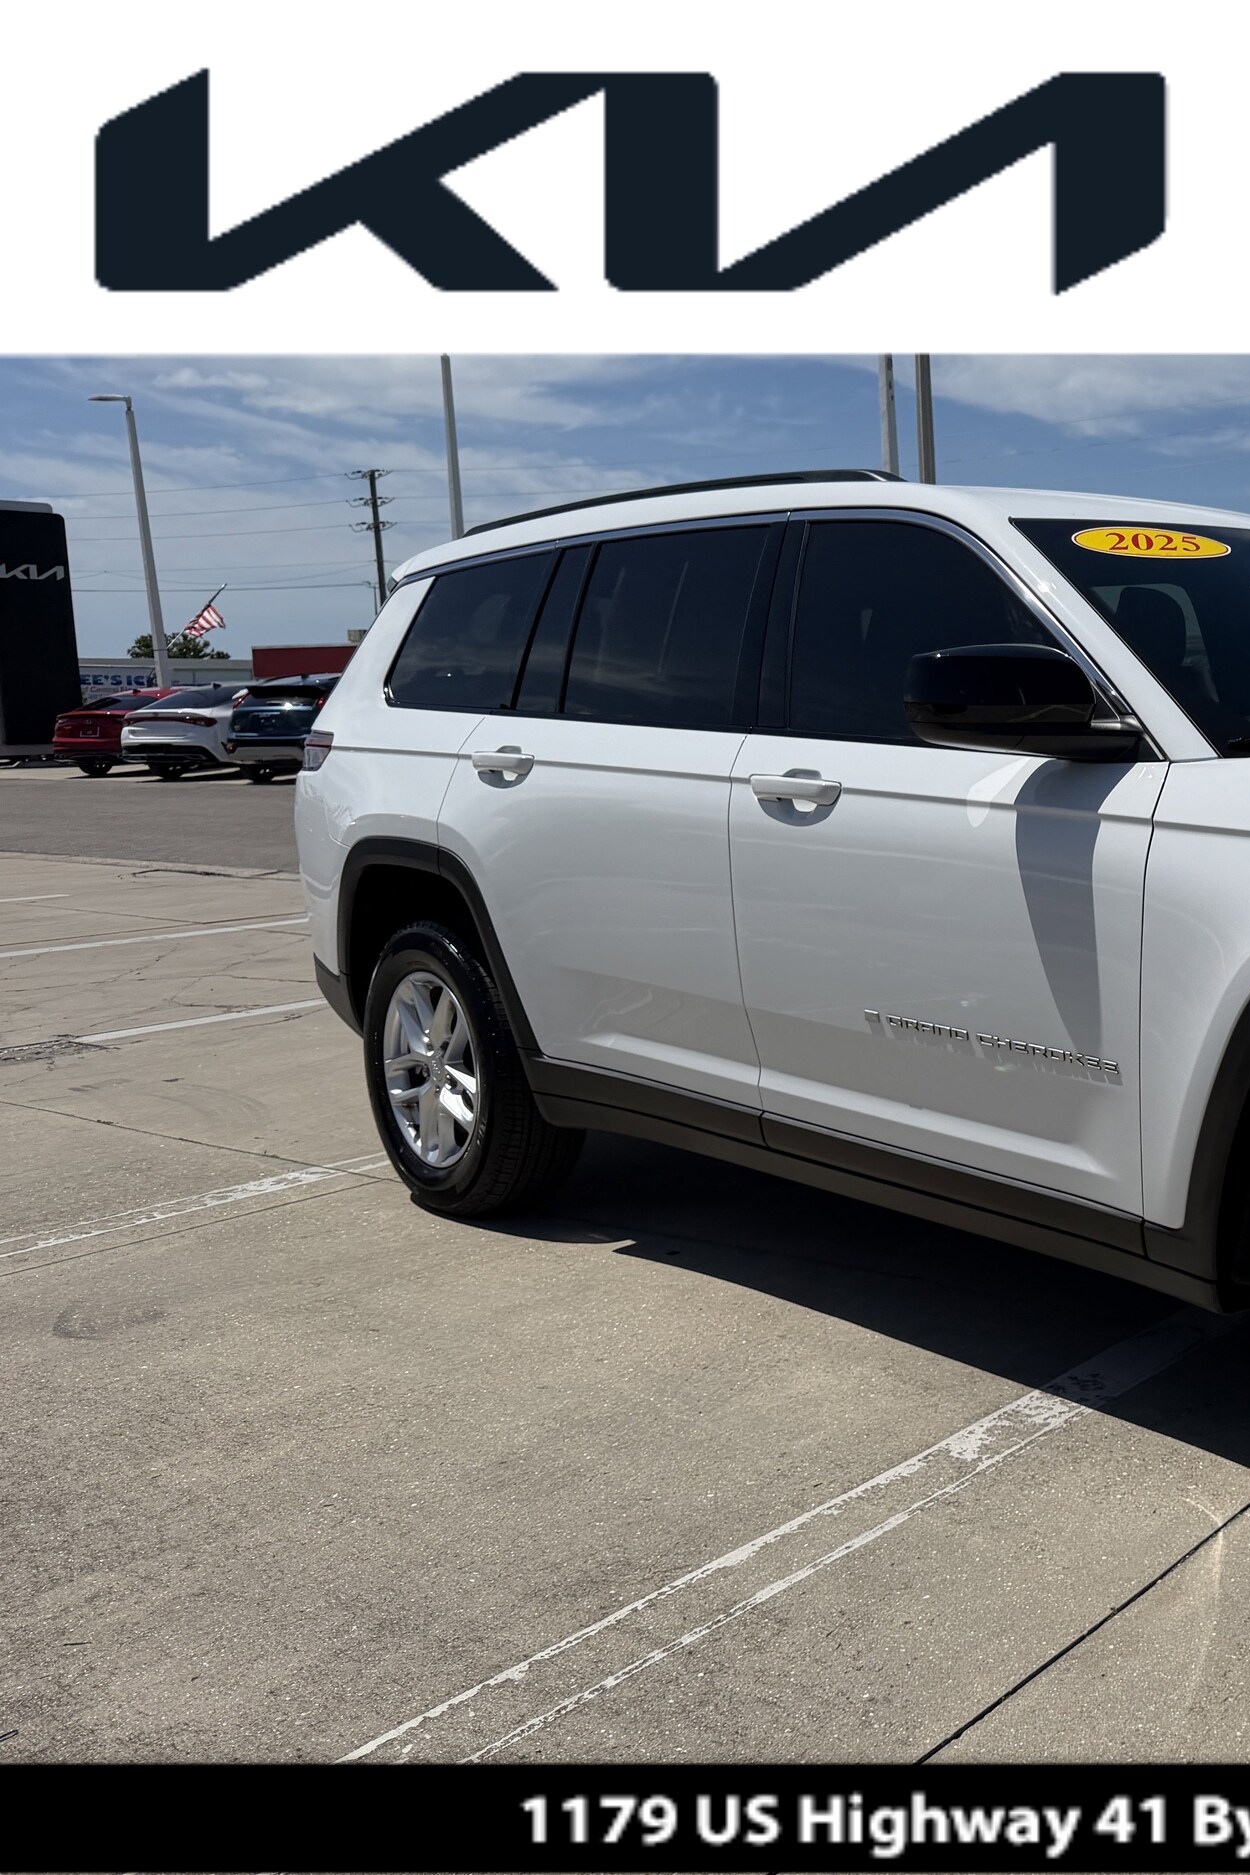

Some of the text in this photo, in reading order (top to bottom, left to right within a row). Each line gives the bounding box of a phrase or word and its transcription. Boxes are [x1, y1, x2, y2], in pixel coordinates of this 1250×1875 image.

[1105, 532, 1201, 552] 2025
[80, 674, 122, 686] EE'S
[886, 1014, 1120, 1075] GRAND CHEROKEE
